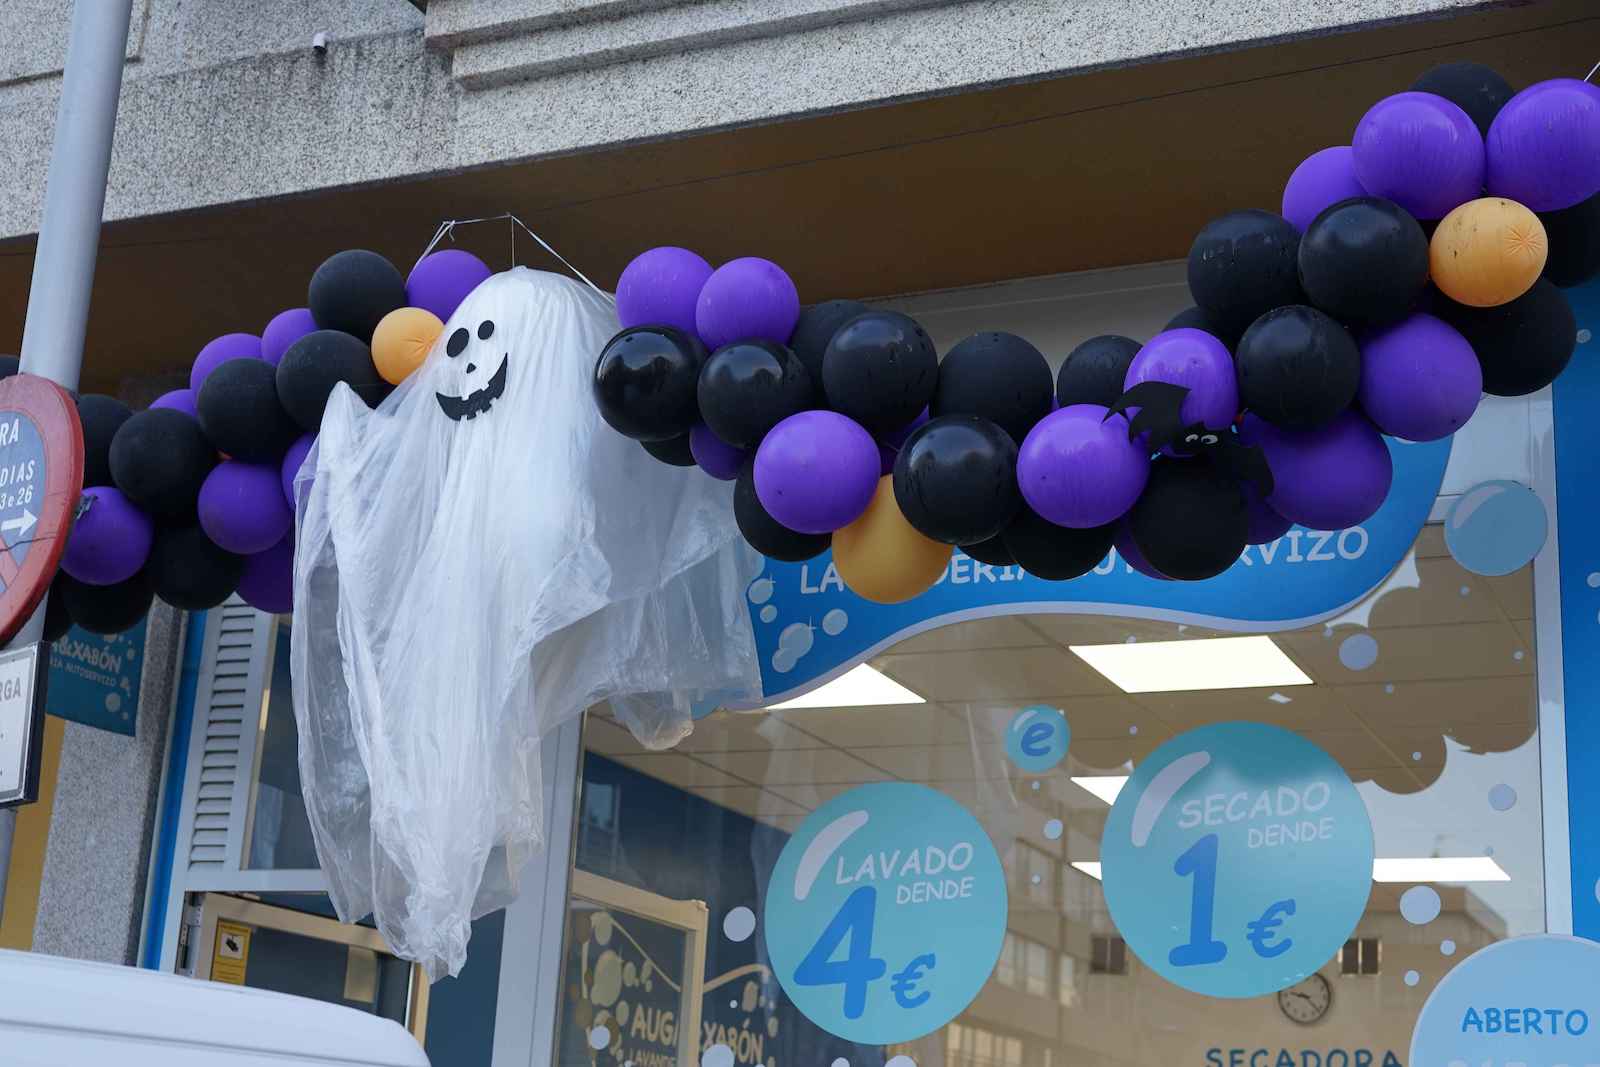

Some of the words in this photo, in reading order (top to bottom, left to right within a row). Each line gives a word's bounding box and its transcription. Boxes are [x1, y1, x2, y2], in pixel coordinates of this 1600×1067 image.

[1178, 781, 1332, 829] SECADO
[1248, 817, 1335, 850] DENDE
[835, 842, 974, 885] LAVADO
[896, 876, 975, 905] DENDE
[1168, 833, 1228, 967] 1
[1246, 898, 1297, 958] €
[793, 885, 887, 1020] 4
[890, 952, 937, 1009] €
[1462, 1006, 1589, 1037] ABERTO
